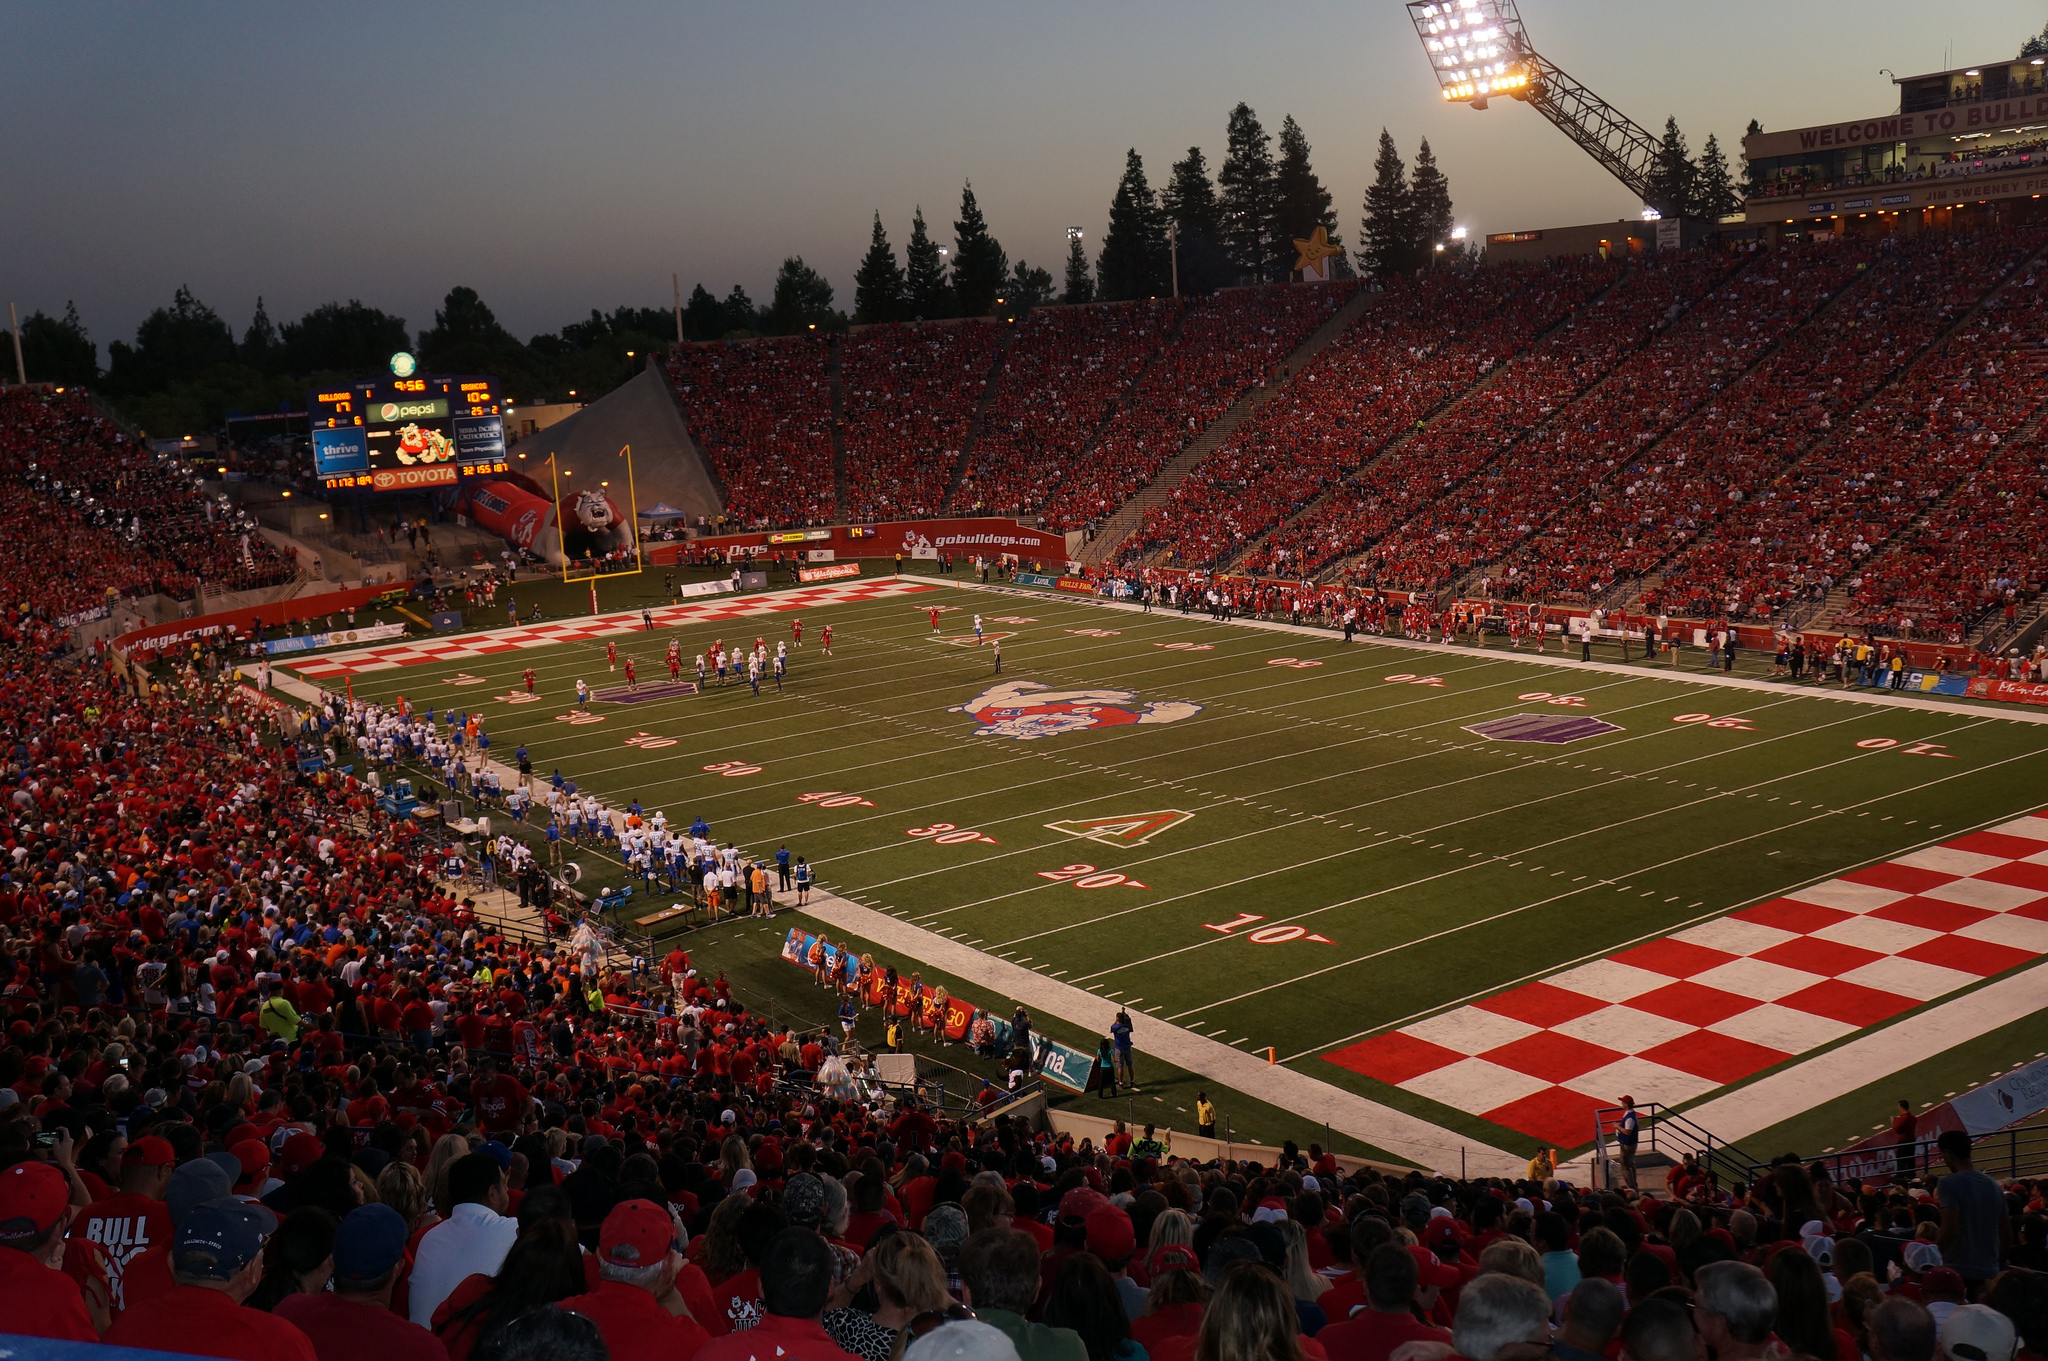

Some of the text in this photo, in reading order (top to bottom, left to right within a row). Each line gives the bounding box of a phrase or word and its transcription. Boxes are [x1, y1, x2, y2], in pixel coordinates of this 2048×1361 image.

[1800, 119, 1913, 149] WELCOME
[1925, 111, 1955, 132] TO
[1926, 190, 1947, 201] JIM
[1954, 182, 2019, 198] SWEENEY
[394, 380, 425, 391] 9:56
[443, 384, 448, 392] 1
[461, 383, 488, 391] BRONCOS
[318, 392, 351, 402] BULLDOGS
[366, 389, 372, 398] 1
[467, 392, 480, 403] 10
[336, 402, 351, 413] 17
[400, 403, 435, 418] pepsi
[471, 406, 484, 416] 25
[491, 405, 499, 415] 2
[328, 417, 336, 428] 2
[354, 415, 362, 426] 6
[323, 443, 358, 455] thrive
[463, 466, 475, 475] 32
[477, 465, 492, 474] 155
[494, 463, 509, 472] 187
[357, 475, 373, 486] 189
[397, 468, 456, 484] TOYOTA
[326, 479, 337, 489] 17
[339, 477, 355, 487] 172
[851, 527, 863, 538] 14
[935, 533, 1041, 547] gobulldogs.com
[729, 544, 768, 557] Dogs
[1060, 580, 1094, 591] WELLS FAR
[1516, 692, 1588, 706] 30
[555, 711, 605, 725] 30
[1671, 713, 1755, 729] 20
[624, 734, 678, 749] 40
[1854, 738, 1948, 755] 10
[702, 760, 764, 777] 50
[795, 791, 863, 808] 40
[905, 823, 985, 845] 30
[1035, 863, 1128, 889] 20
[1202, 912, 1307, 944] 10
[142, 968, 159, 976] THIS
[911, 1130, 918, 1145] 1
[86, 1216, 150, 1246] BULL
